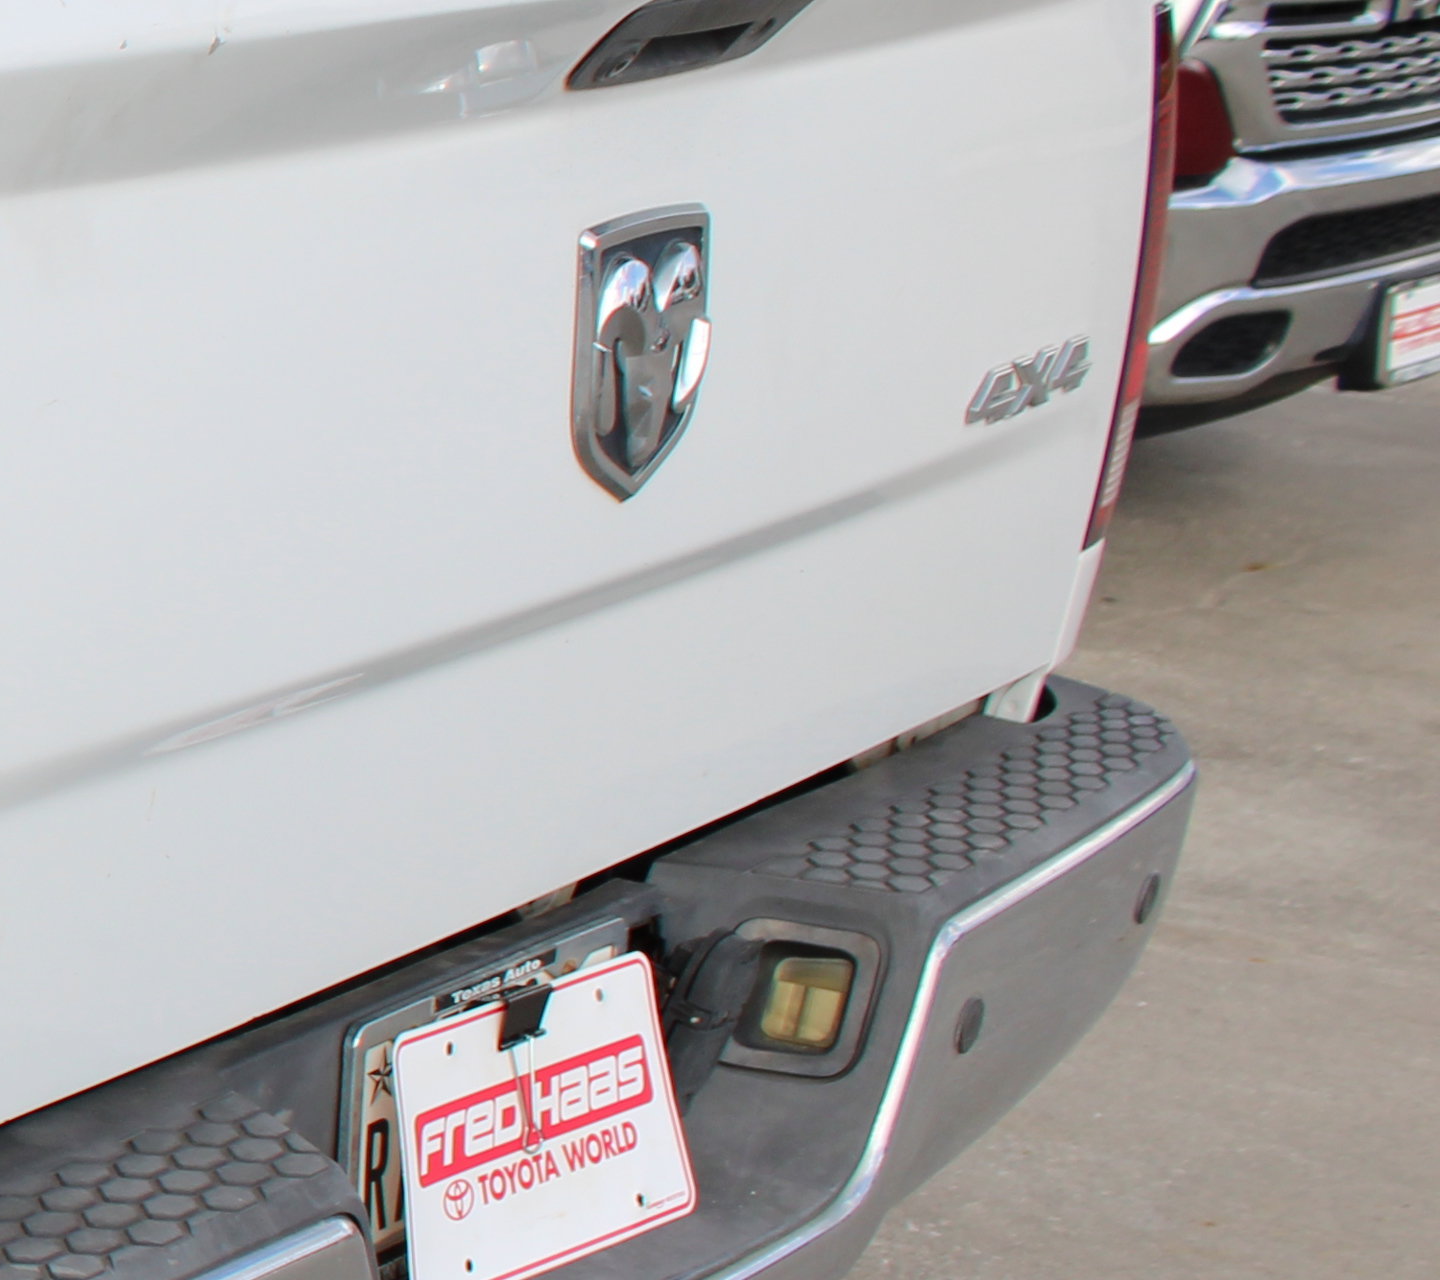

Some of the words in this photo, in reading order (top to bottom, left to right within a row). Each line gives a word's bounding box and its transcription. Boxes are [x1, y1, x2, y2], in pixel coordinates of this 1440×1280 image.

[451, 976, 501, 1004] Texas
[504, 959, 542, 983] Auto
[478, 1150, 561, 1206] TOYOTA
[561, 1121, 638, 1172] WORLD
